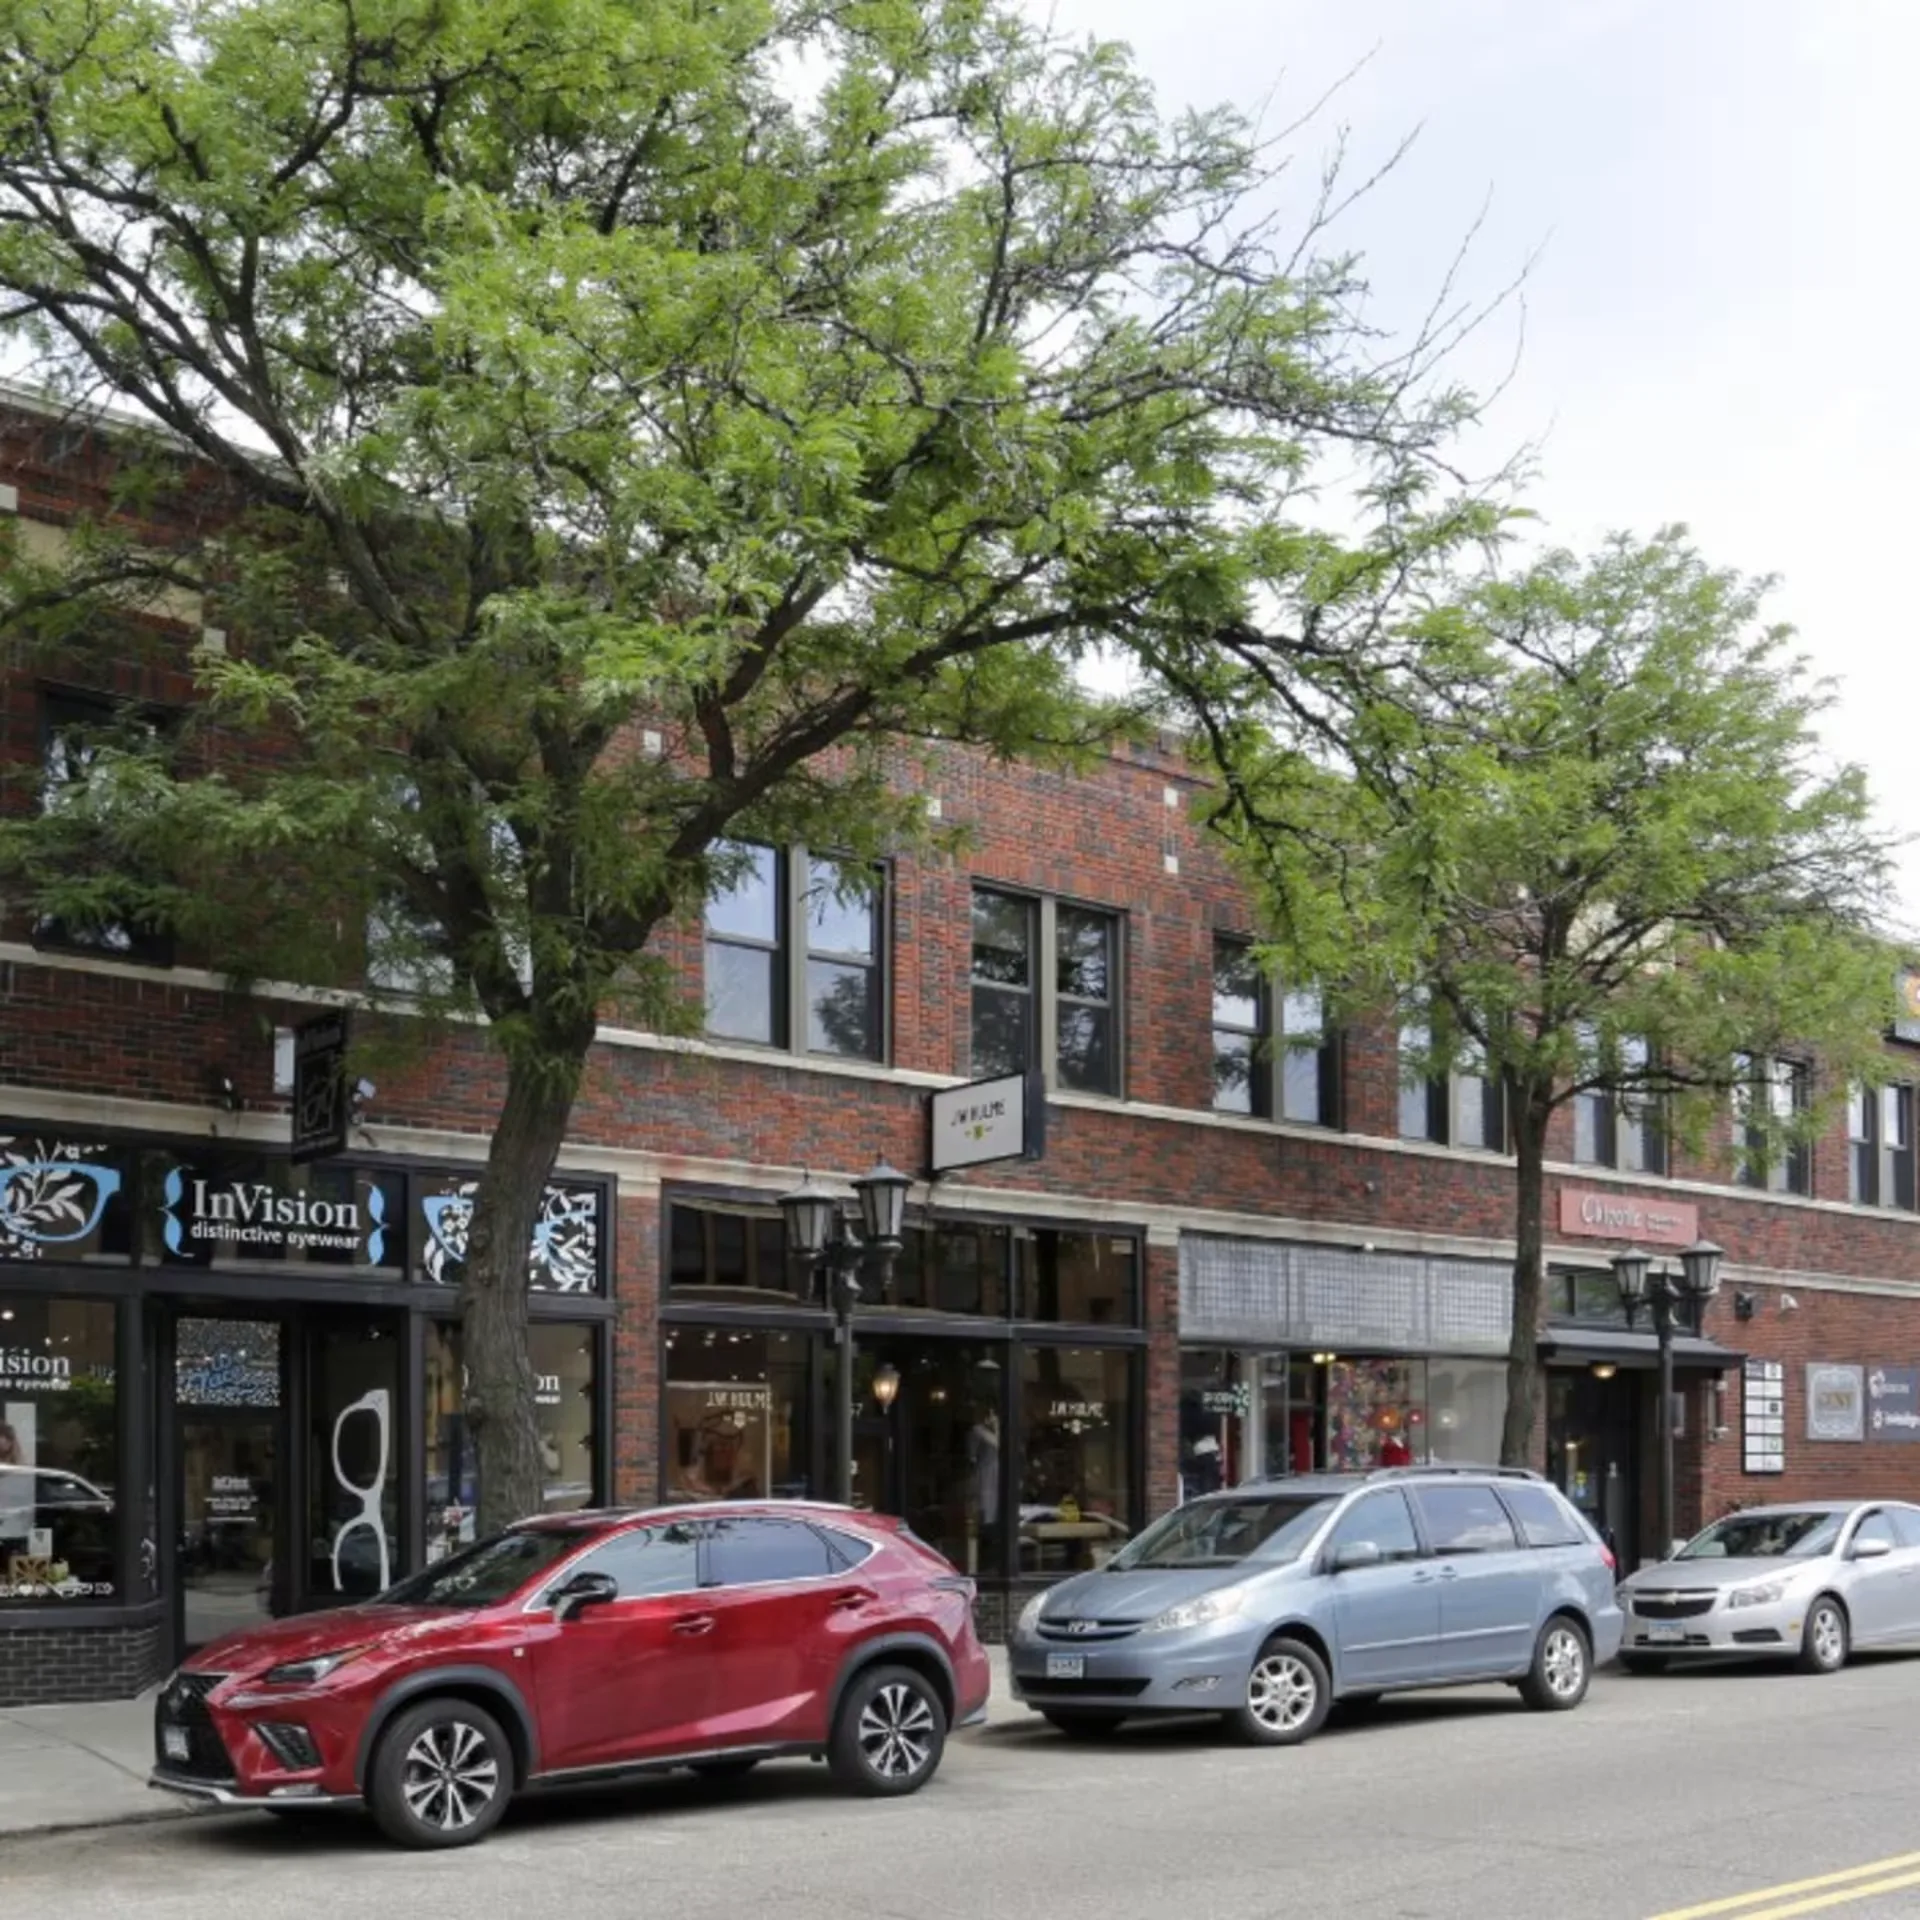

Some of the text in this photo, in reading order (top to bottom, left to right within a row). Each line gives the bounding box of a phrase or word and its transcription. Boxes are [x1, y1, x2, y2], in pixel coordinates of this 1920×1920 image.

[191, 1178, 361, 1231] InVision
[190, 1221, 363, 1250] distinctive eyewear
